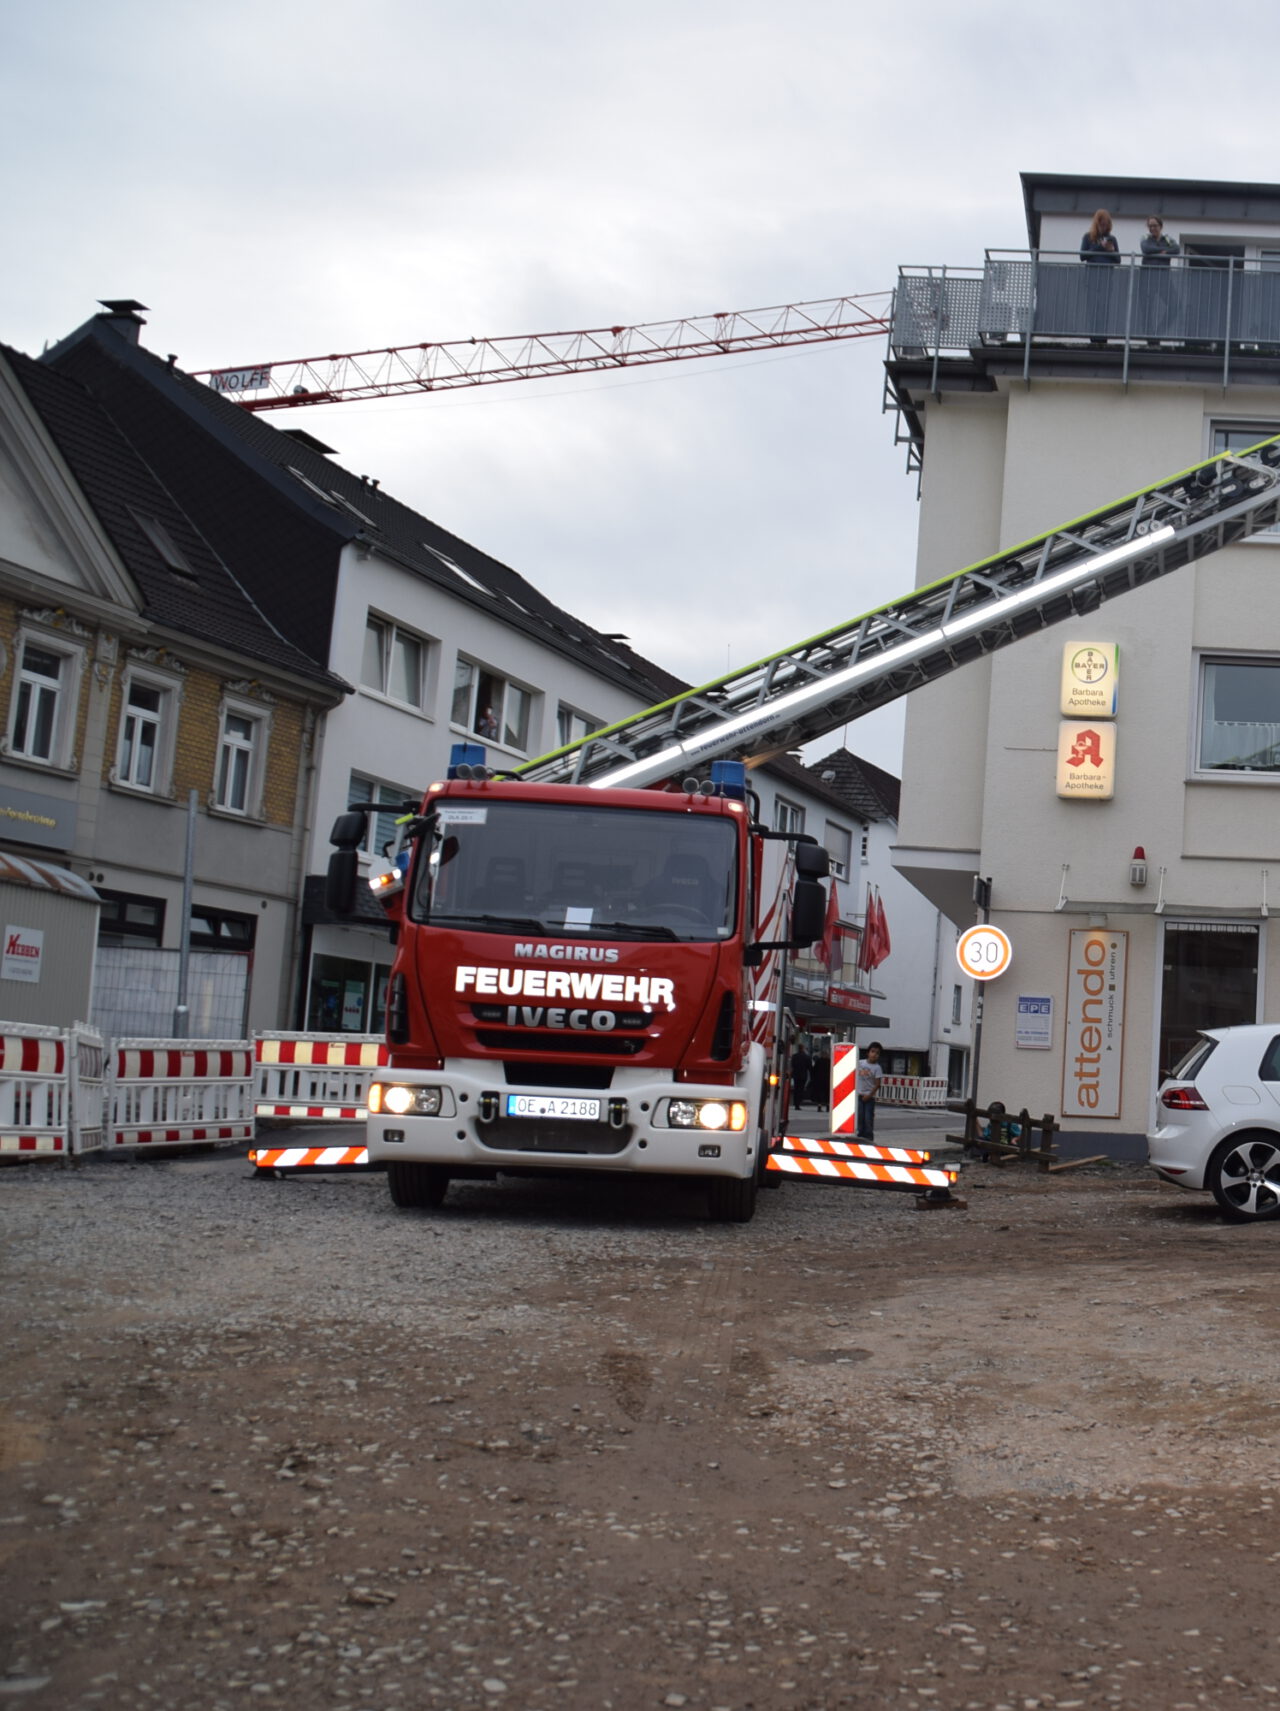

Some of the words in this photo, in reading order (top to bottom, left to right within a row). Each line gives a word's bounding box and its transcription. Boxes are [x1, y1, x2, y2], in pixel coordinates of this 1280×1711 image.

[214, 369, 270, 391] WOLFF
[1074, 661, 1105, 669] BAYER
[1085, 651, 1094, 681] BAYER
[1068, 697, 1106, 707] Apotheke
[1071, 687, 1104, 697] Barbara
[1064, 781, 1105, 791] Apotheke
[1069, 772, 1106, 782] Barbara-
[514, 943, 619, 963] MAGIRUS
[970, 941, 998, 963] 30
[1109, 951, 1117, 980] uhren
[455, 965, 674, 1005] FEUERWEHR
[506, 1005, 617, 1031] IVECO
[1019, 1003, 1050, 1013] EPE
[1107, 994, 1115, 1038] schmuck
[1073, 939, 1107, 1109] attendo
[518, 1098, 537, 1113] OE
[547, 1100, 557, 1114] A
[560, 1101, 598, 1117] 2188
